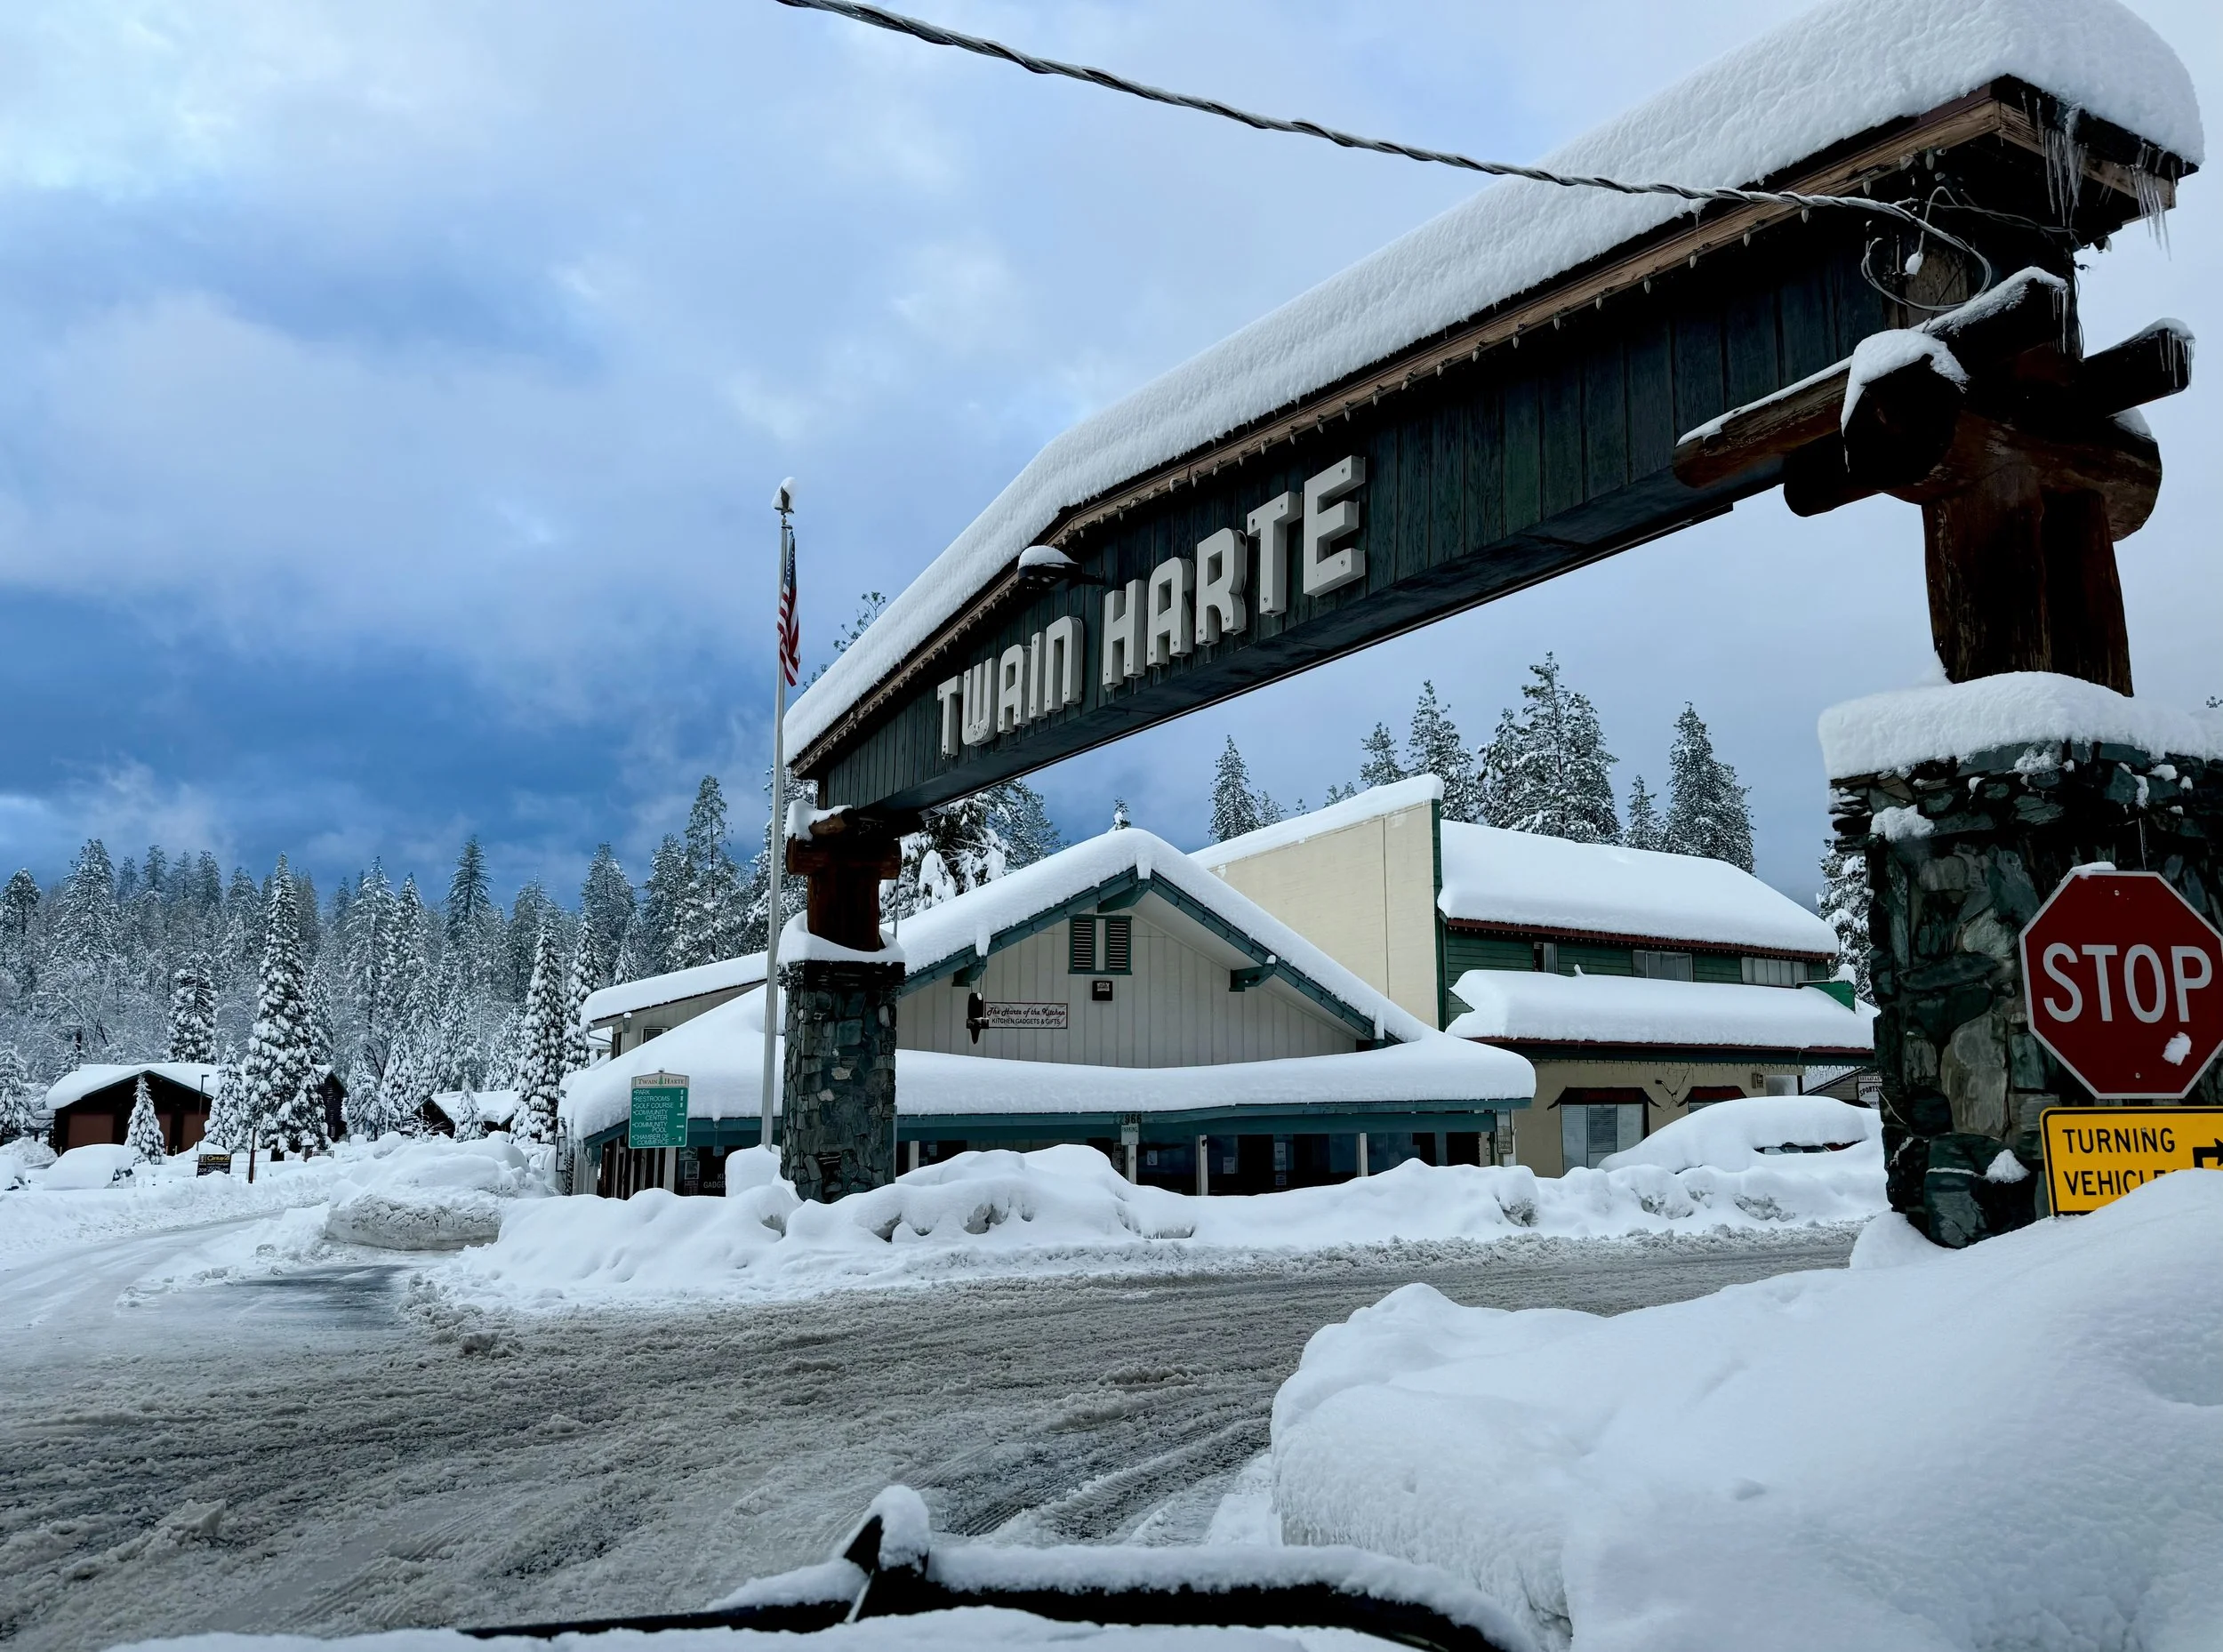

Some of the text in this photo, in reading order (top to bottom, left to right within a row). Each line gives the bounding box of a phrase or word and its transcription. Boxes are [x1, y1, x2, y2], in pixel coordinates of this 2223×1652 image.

[937, 455, 1366, 758] TWAIN HARTE
[2042, 942, 2212, 1023] STOP
[987, 1007, 999, 1016] The
[1001, 1007, 1022, 1016] Harte
[1023, 1007, 1031, 1018] of
[1041, 1007, 1065, 1016] Kitchen
[2062, 1127, 2176, 1154] TURNING
[702, 1181, 726, 1189] GADGE
[2063, 1169, 2179, 1196] VEHIC
